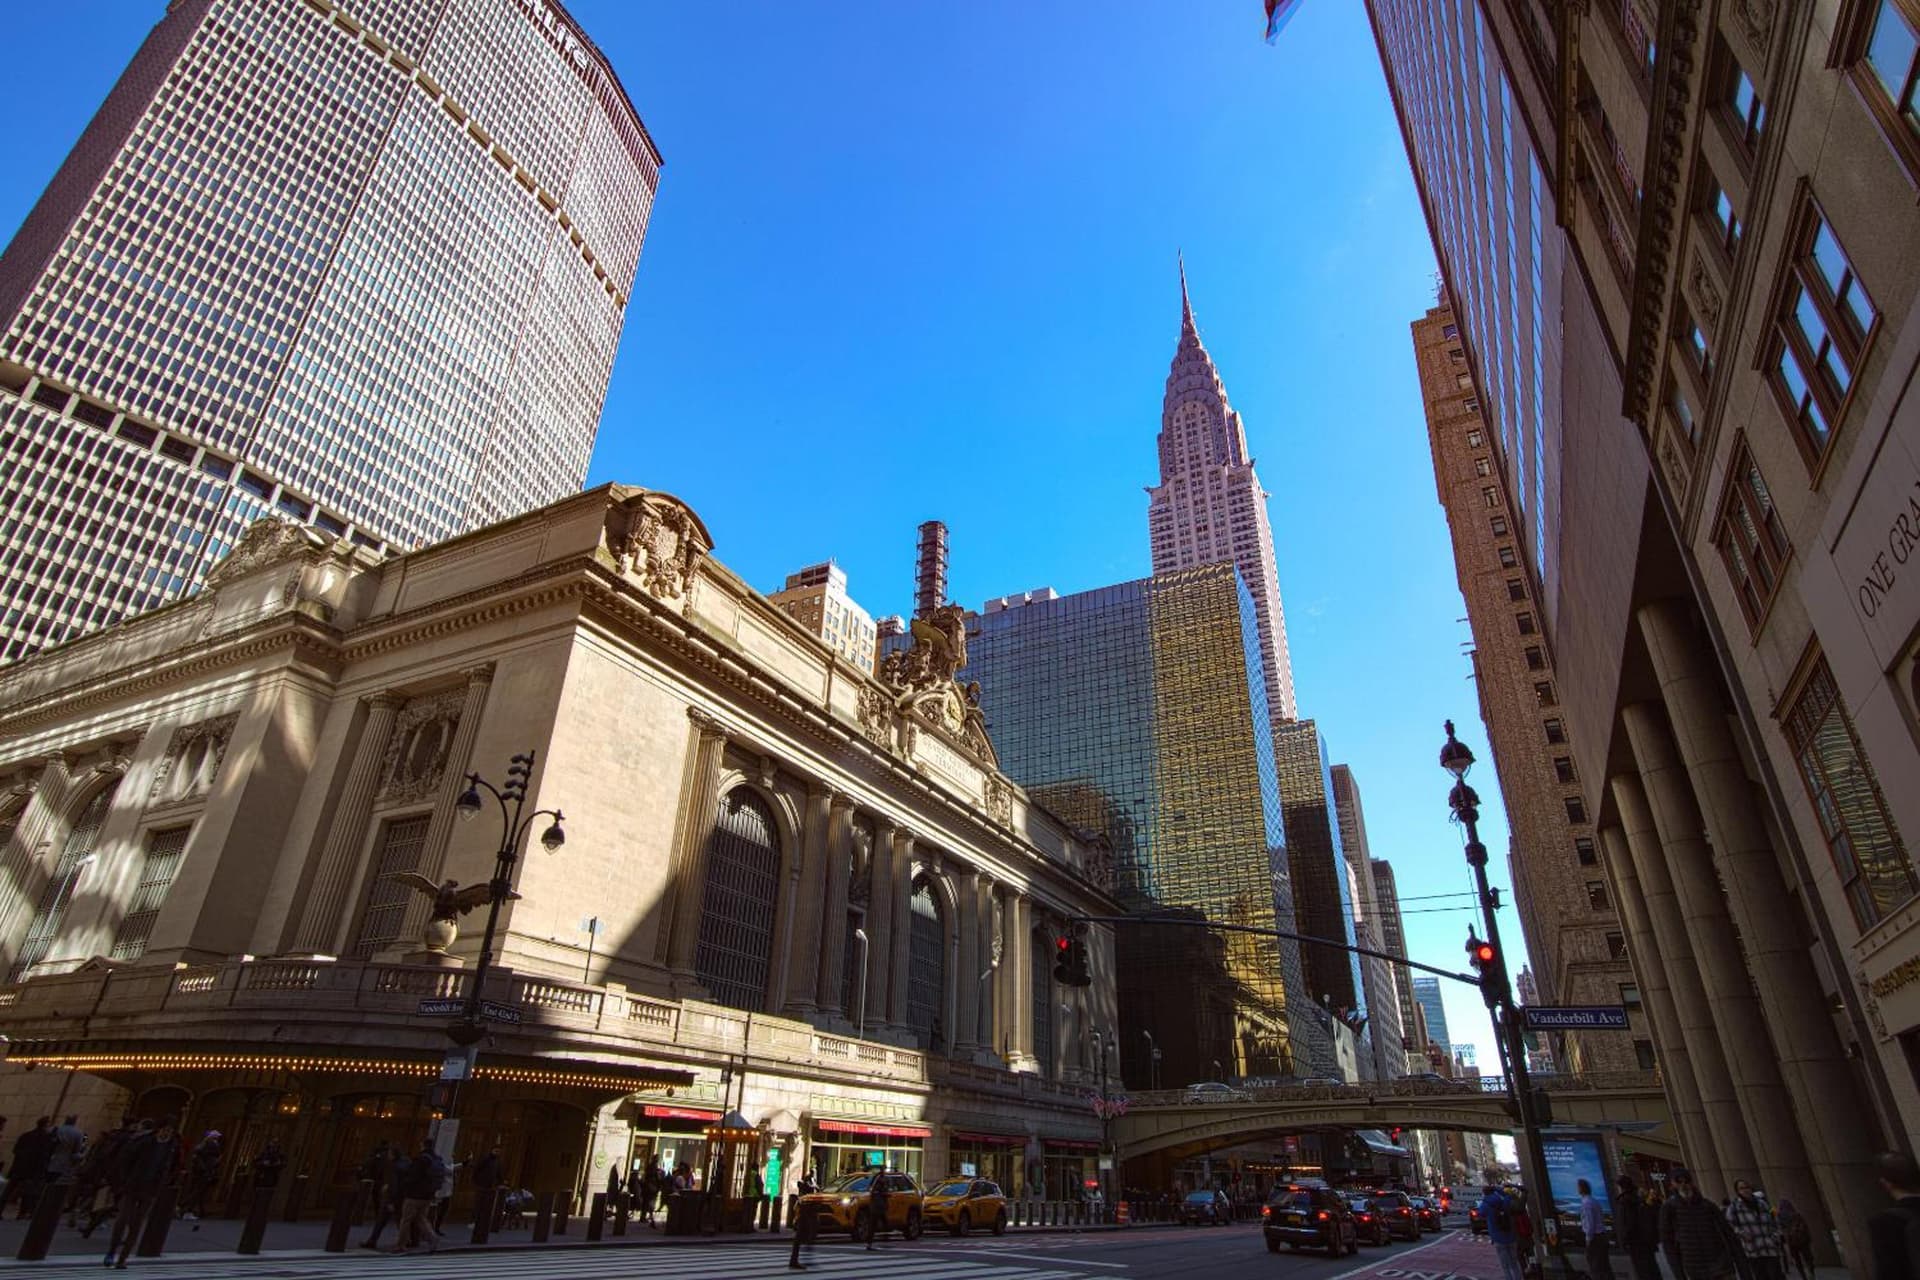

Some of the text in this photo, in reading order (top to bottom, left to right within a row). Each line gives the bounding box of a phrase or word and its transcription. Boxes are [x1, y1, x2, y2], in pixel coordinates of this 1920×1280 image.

[1859, 481, 1920, 618] ONE GRA
[1529, 1012, 1623, 1024] Vanderbilt Ave
[1243, 1078, 1278, 1089] HYATT
